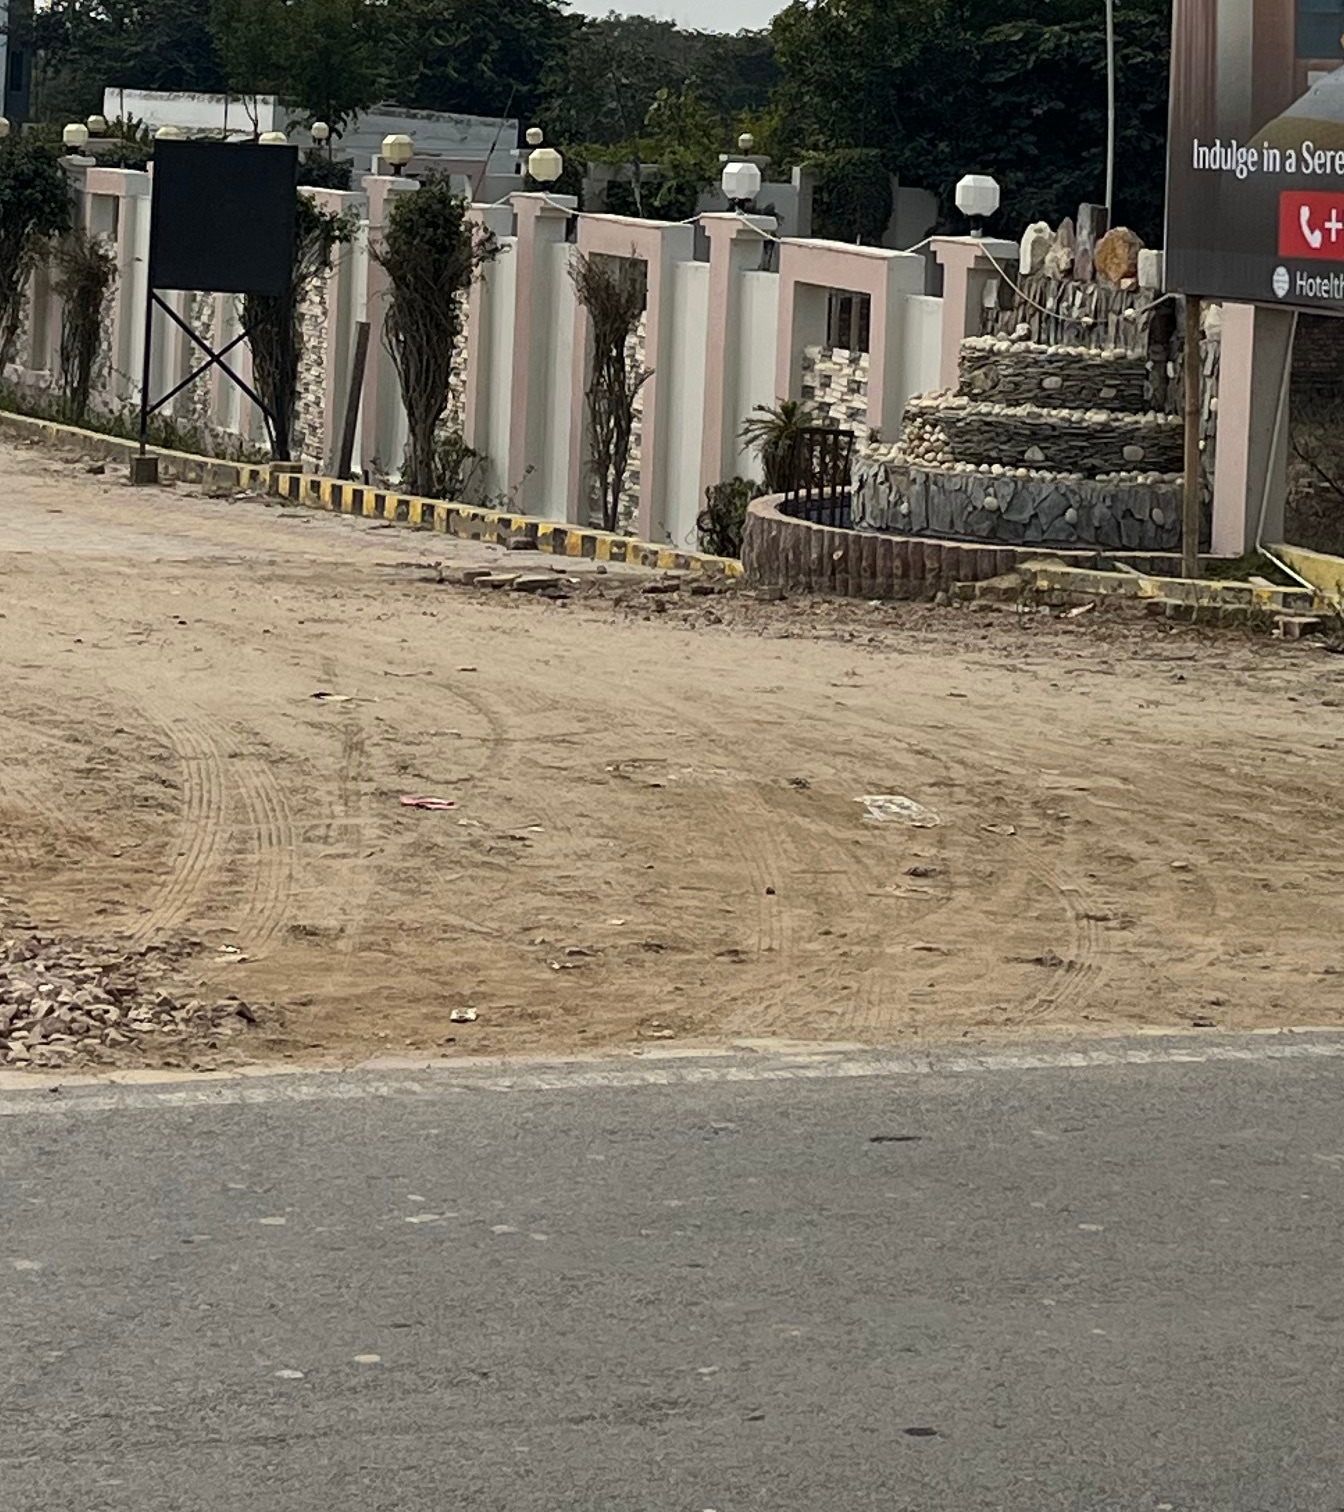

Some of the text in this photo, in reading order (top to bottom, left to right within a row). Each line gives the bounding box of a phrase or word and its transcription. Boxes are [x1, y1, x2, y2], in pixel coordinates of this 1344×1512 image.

[1192, 138, 1258, 179] Indulge
[1262, 141, 1282, 173] in
[1285, 149, 1297, 173] a
